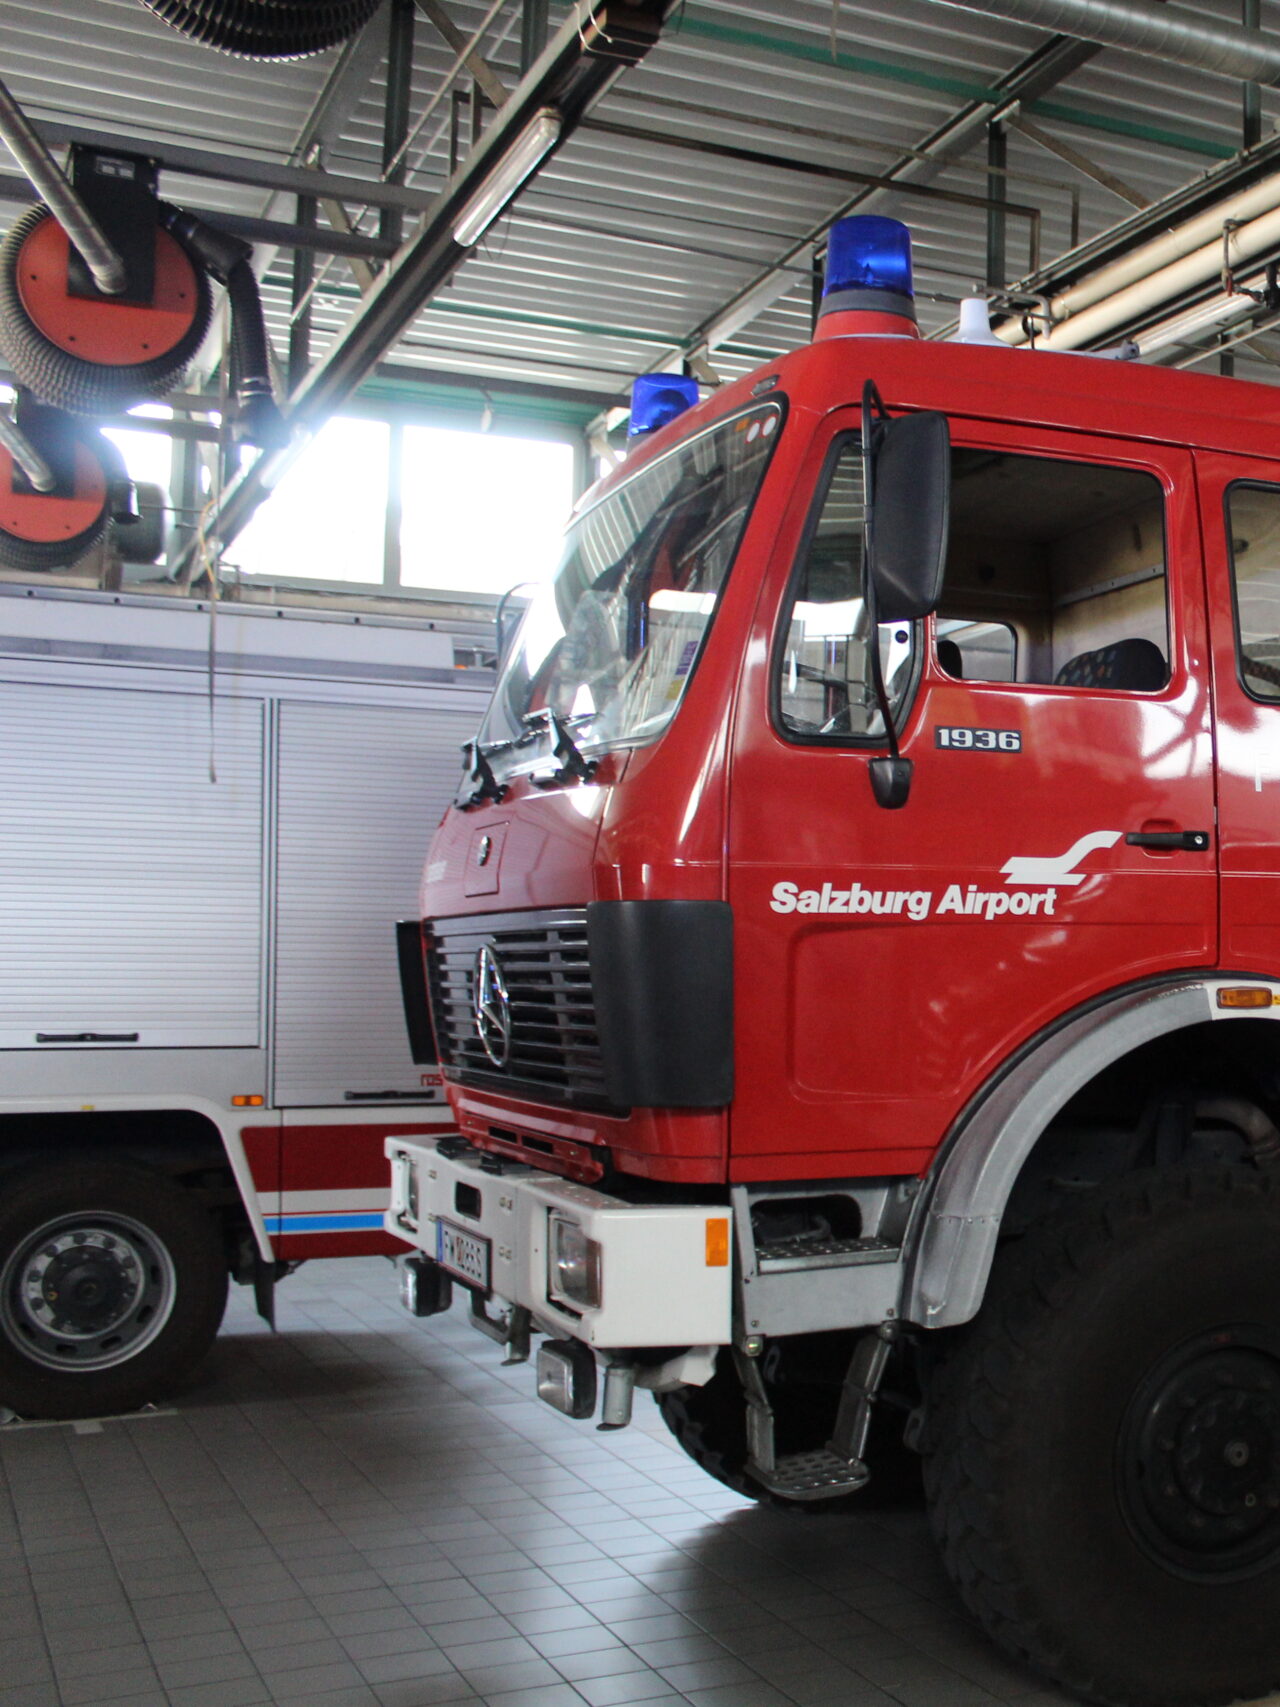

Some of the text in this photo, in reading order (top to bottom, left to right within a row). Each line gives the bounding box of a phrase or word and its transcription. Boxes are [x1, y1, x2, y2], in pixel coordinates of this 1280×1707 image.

[938, 728, 1020, 751] 1936
[769, 881, 1057, 921] Salzburg Airport
